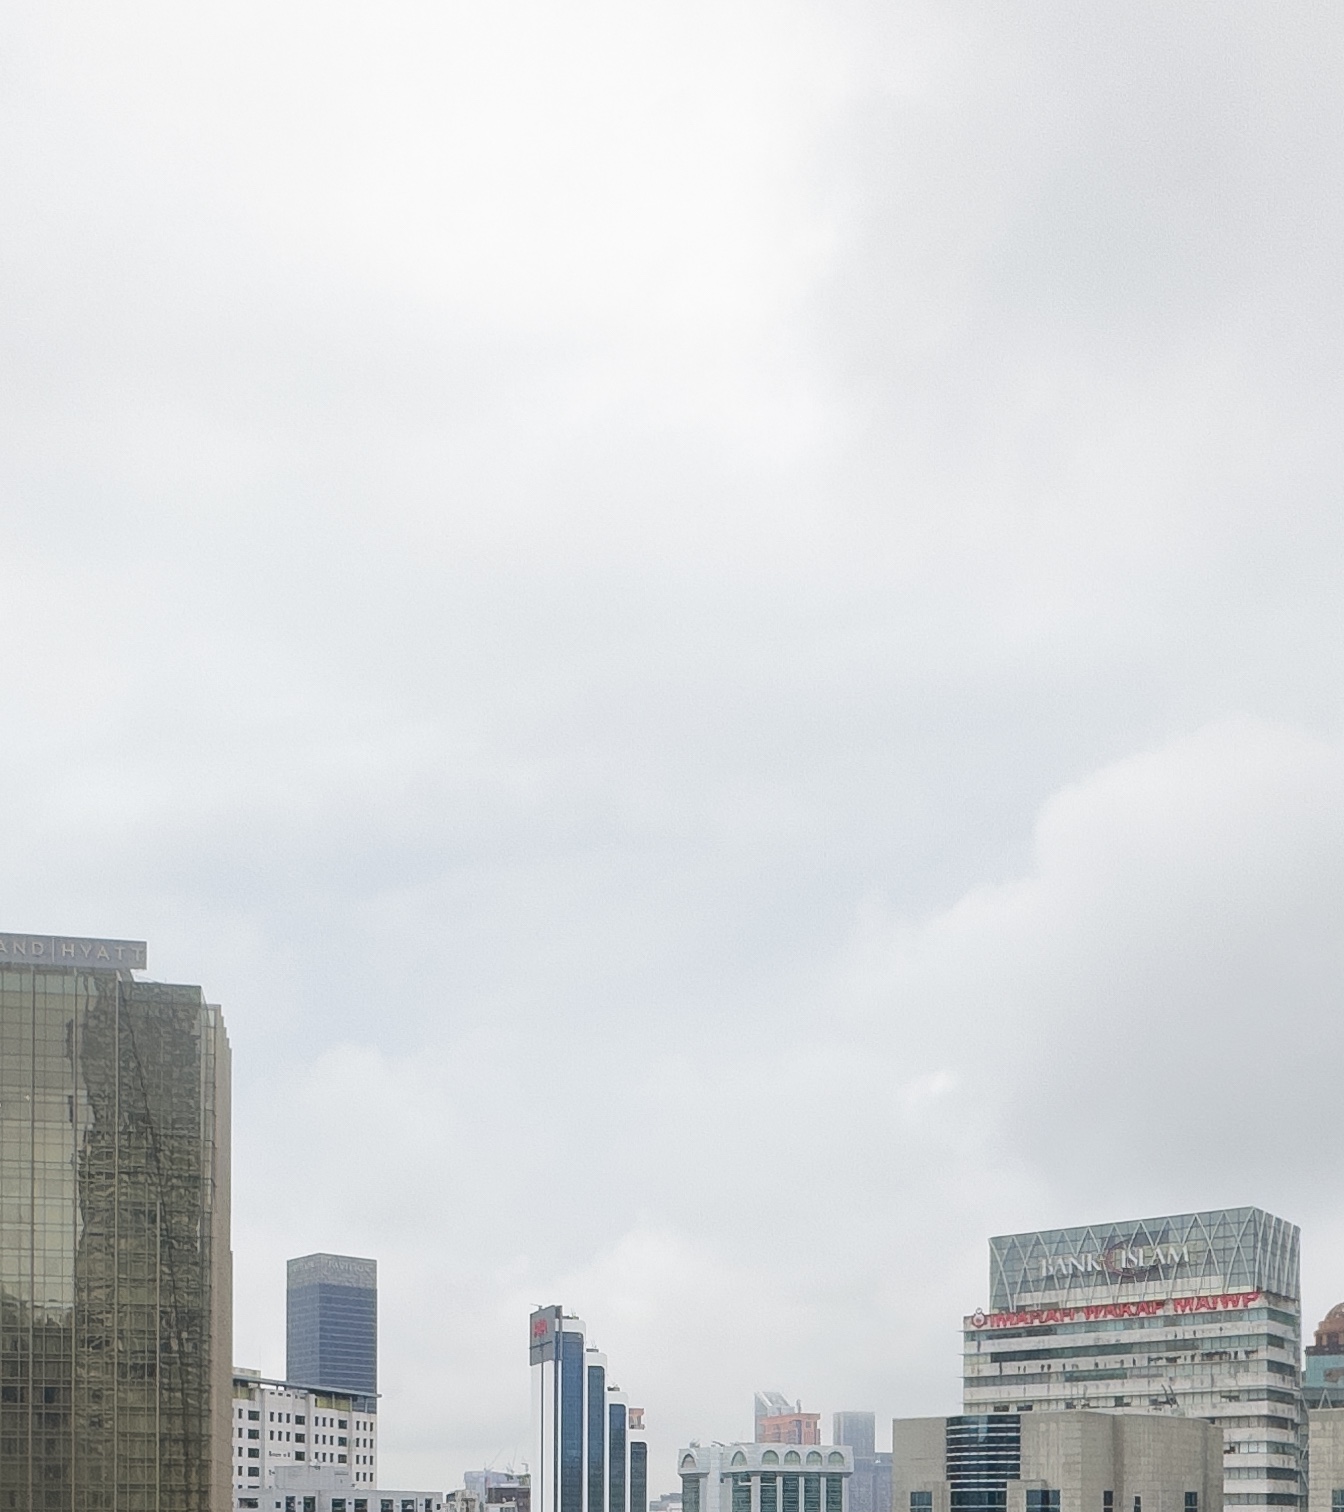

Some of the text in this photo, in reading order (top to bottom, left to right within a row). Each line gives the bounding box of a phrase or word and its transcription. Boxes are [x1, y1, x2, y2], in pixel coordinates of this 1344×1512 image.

[61, 943, 145, 961] HYATT
[1040, 1245, 1190, 1277] BANK ISLAM
[989, 1308, 1075, 1327] IMARAH
[1083, 1300, 1165, 1319] WAKAF
